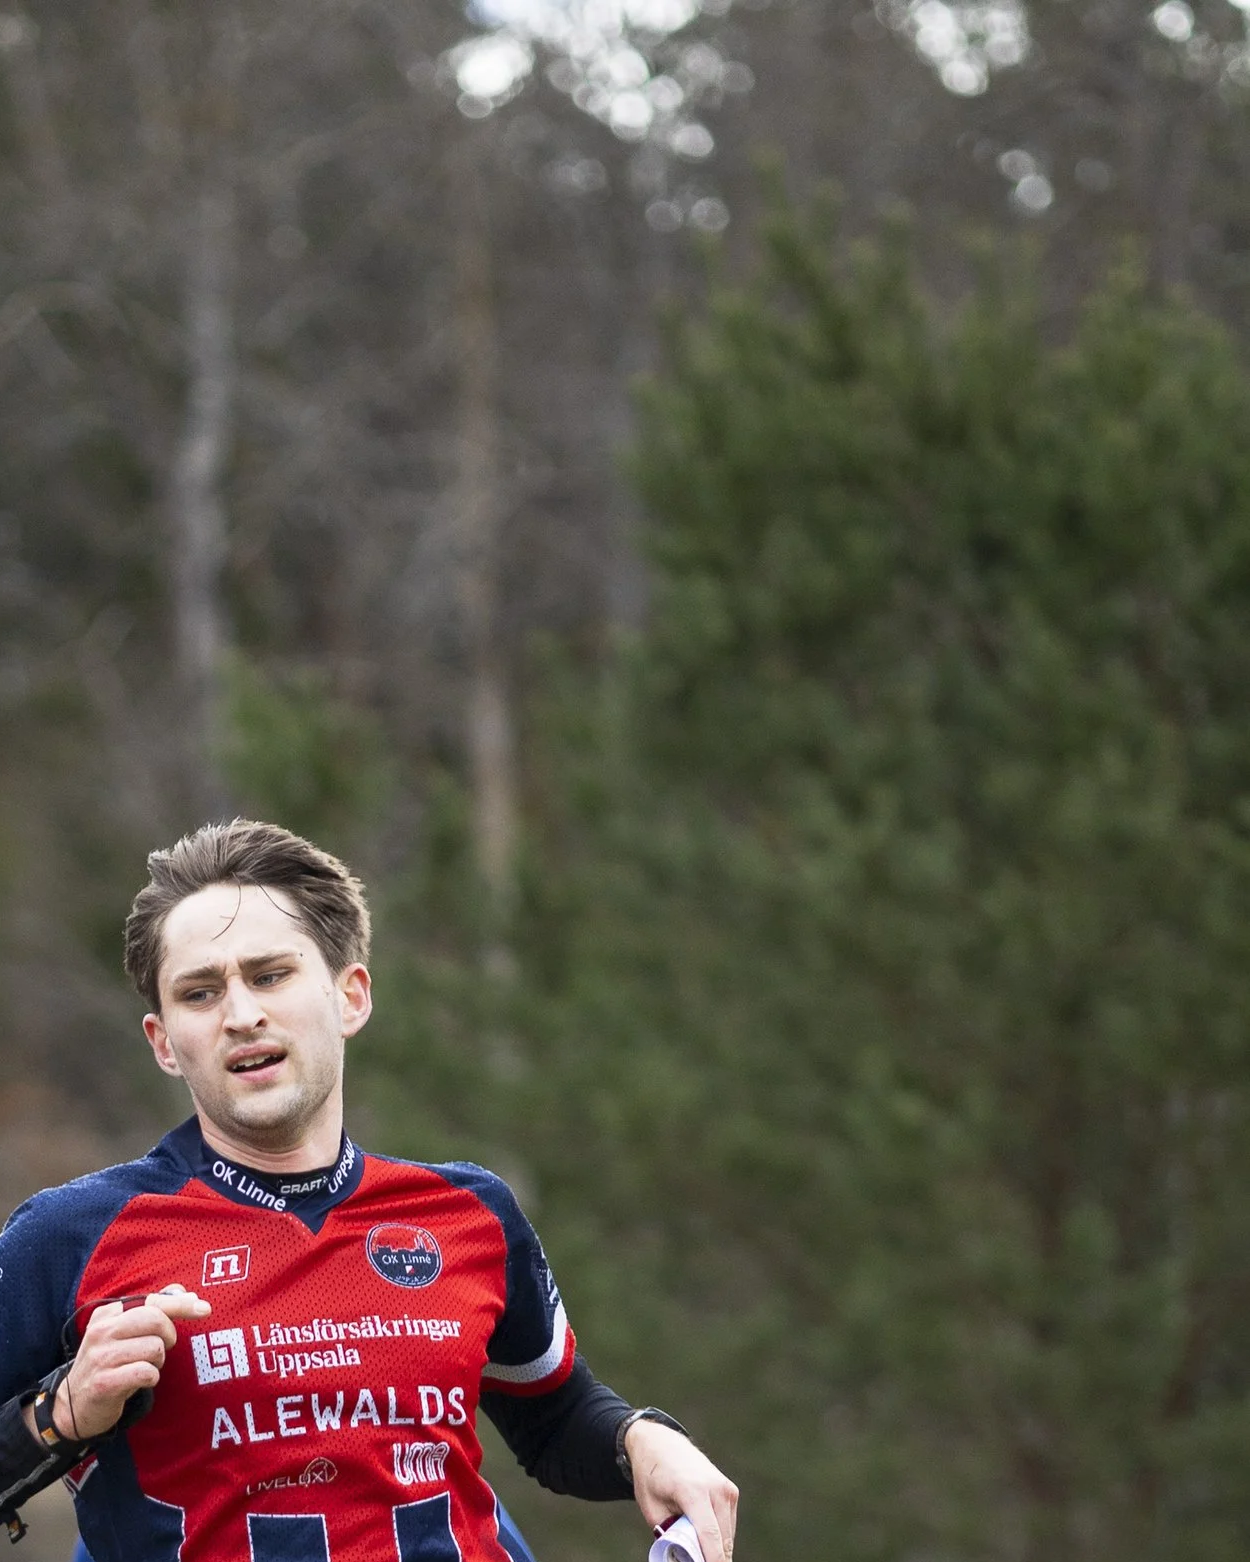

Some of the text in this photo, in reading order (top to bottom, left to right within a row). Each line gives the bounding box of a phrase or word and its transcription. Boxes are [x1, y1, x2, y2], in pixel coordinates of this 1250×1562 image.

[211, 1160, 287, 1212] OK Linné
[280, 1178, 323, 1195] CRAFT
[402, 1253, 432, 1265] Linné
[252, 1313, 462, 1348] Länsförsäkringar
[257, 1344, 362, 1378] Uppsala
[210, 1385, 467, 1450] ALEWALDS
[245, 1470, 325, 1496] LIVELOX
